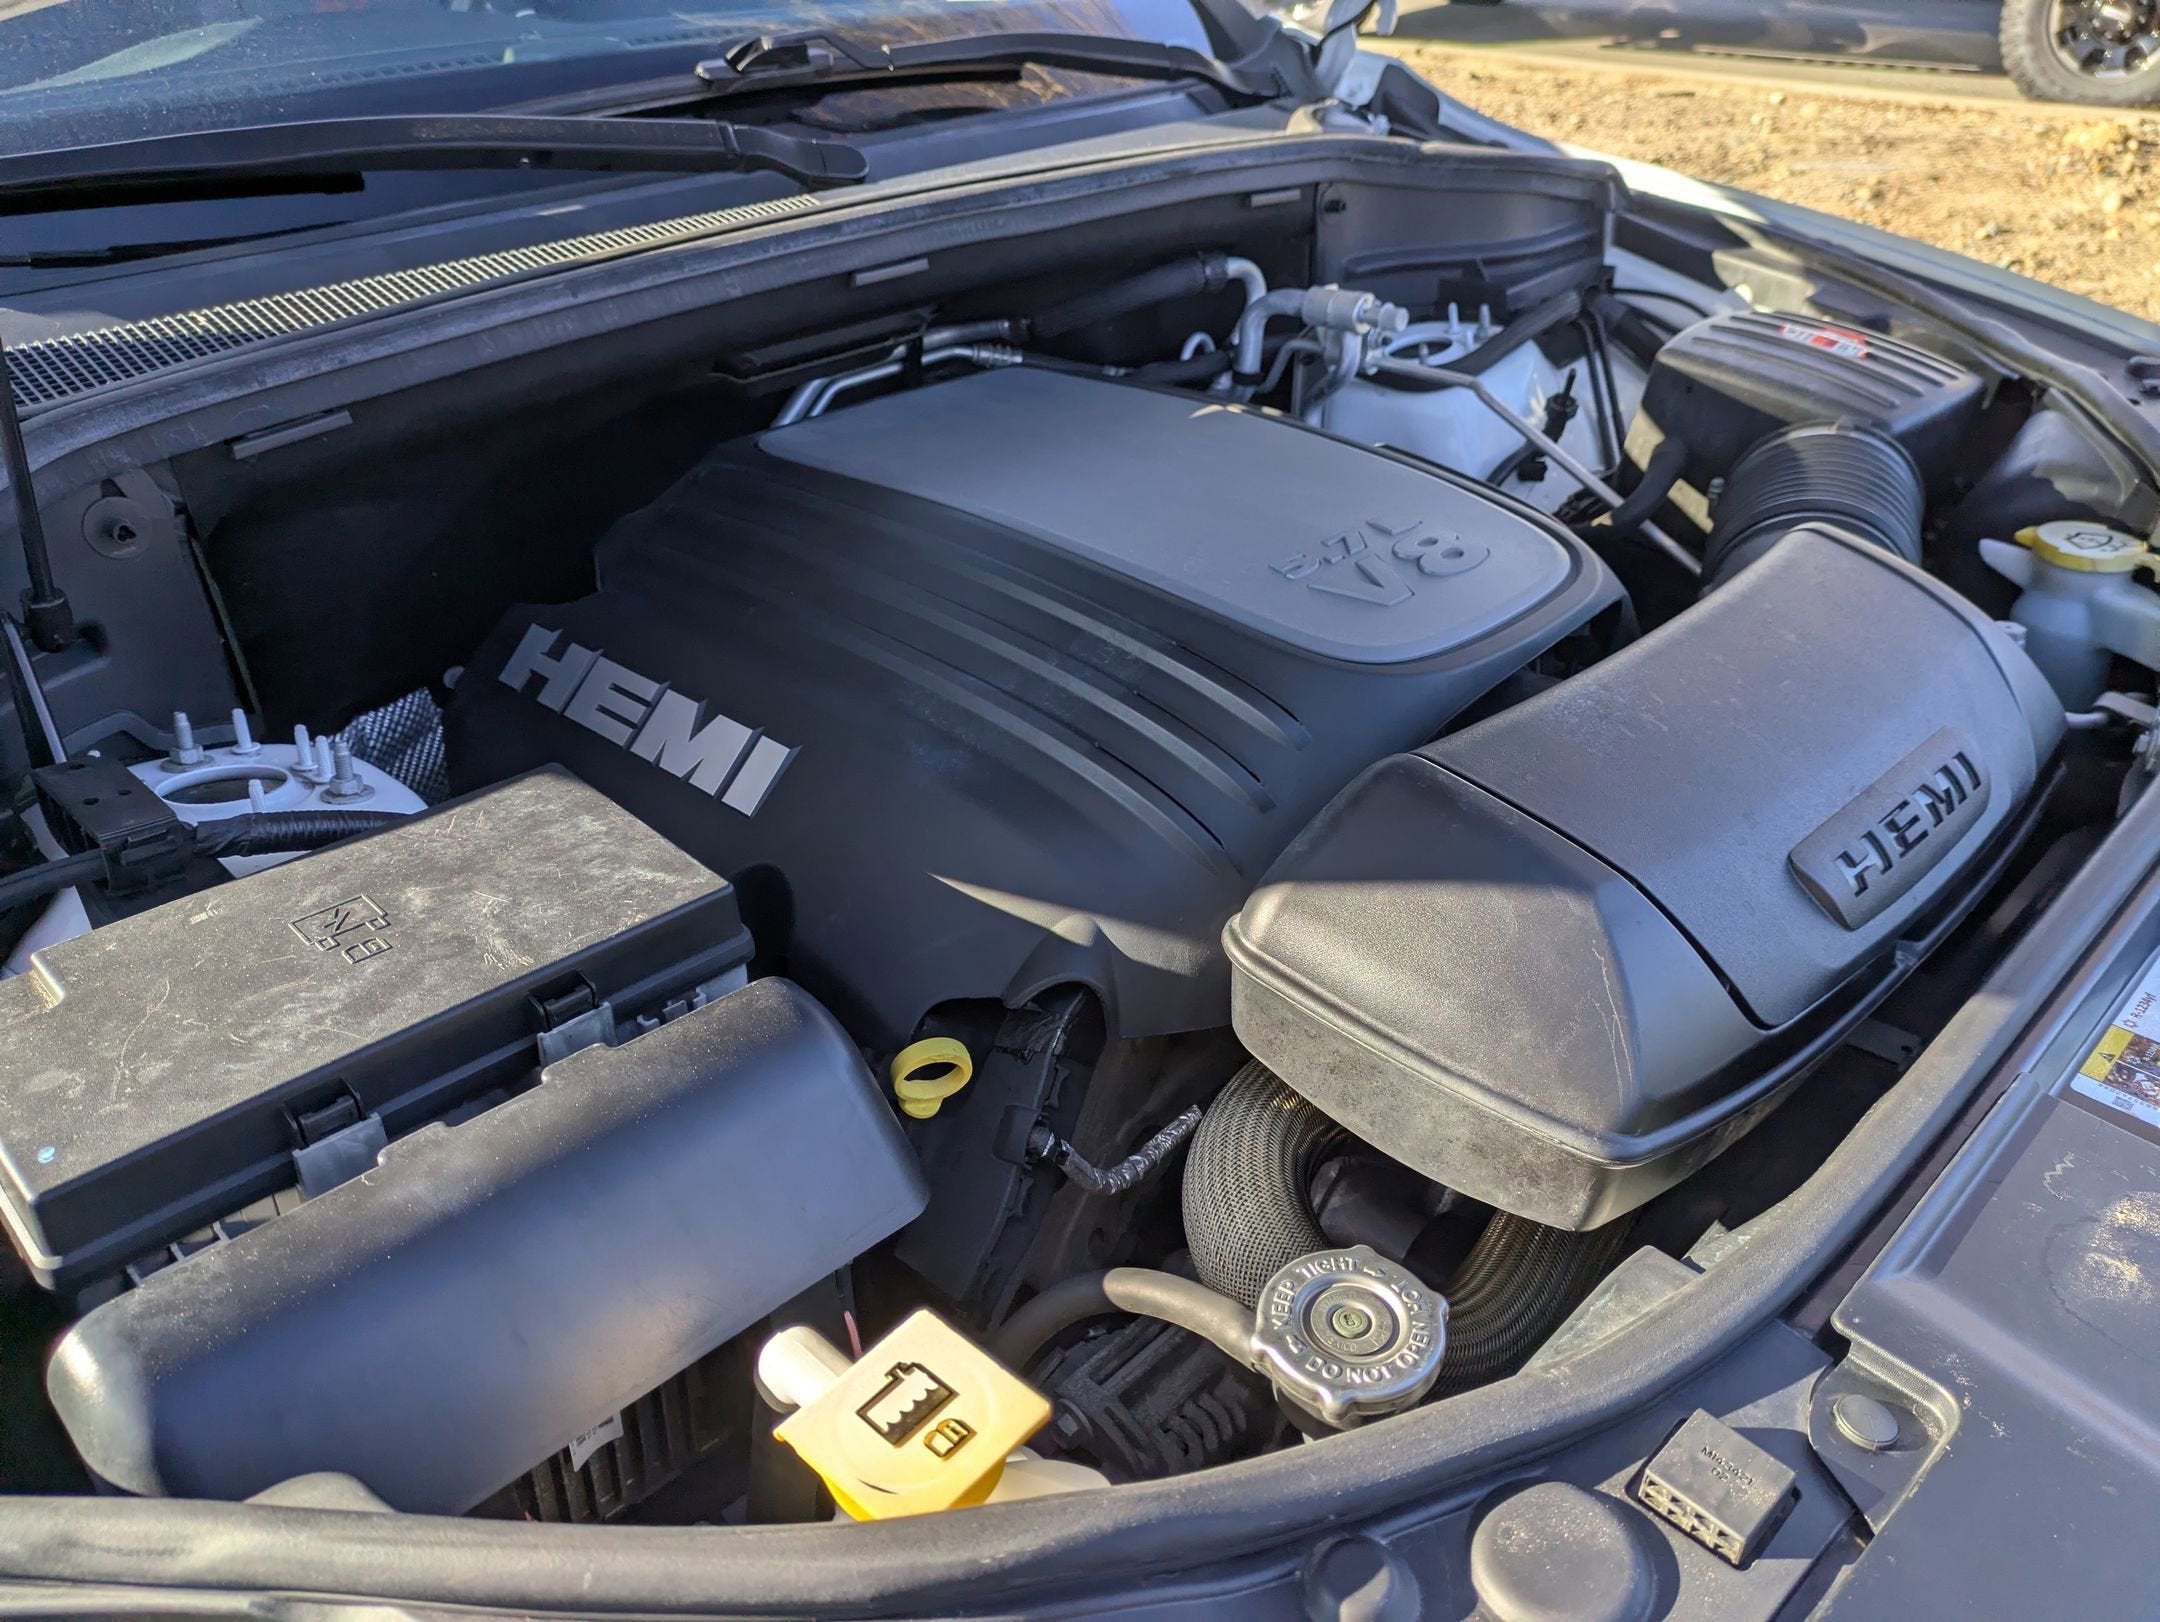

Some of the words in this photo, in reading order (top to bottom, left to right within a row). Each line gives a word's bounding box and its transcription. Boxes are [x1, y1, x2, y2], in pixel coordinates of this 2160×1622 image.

[1306, 530, 1491, 607] V8
[498, 623, 801, 818] HEMI
[1834, 751, 1981, 897] HEMI
[2130, 992, 2157, 1019] R-1234yf
[1272, 1279, 1296, 1331] KEEP
[1296, 1257, 1359, 1279] TIGHT
[1391, 1280, 1432, 1314] HOT
[1305, 1356, 1343, 1379] DO
[1395, 1320, 1432, 1369] OPEN
[1347, 1364, 1392, 1384] NOT
